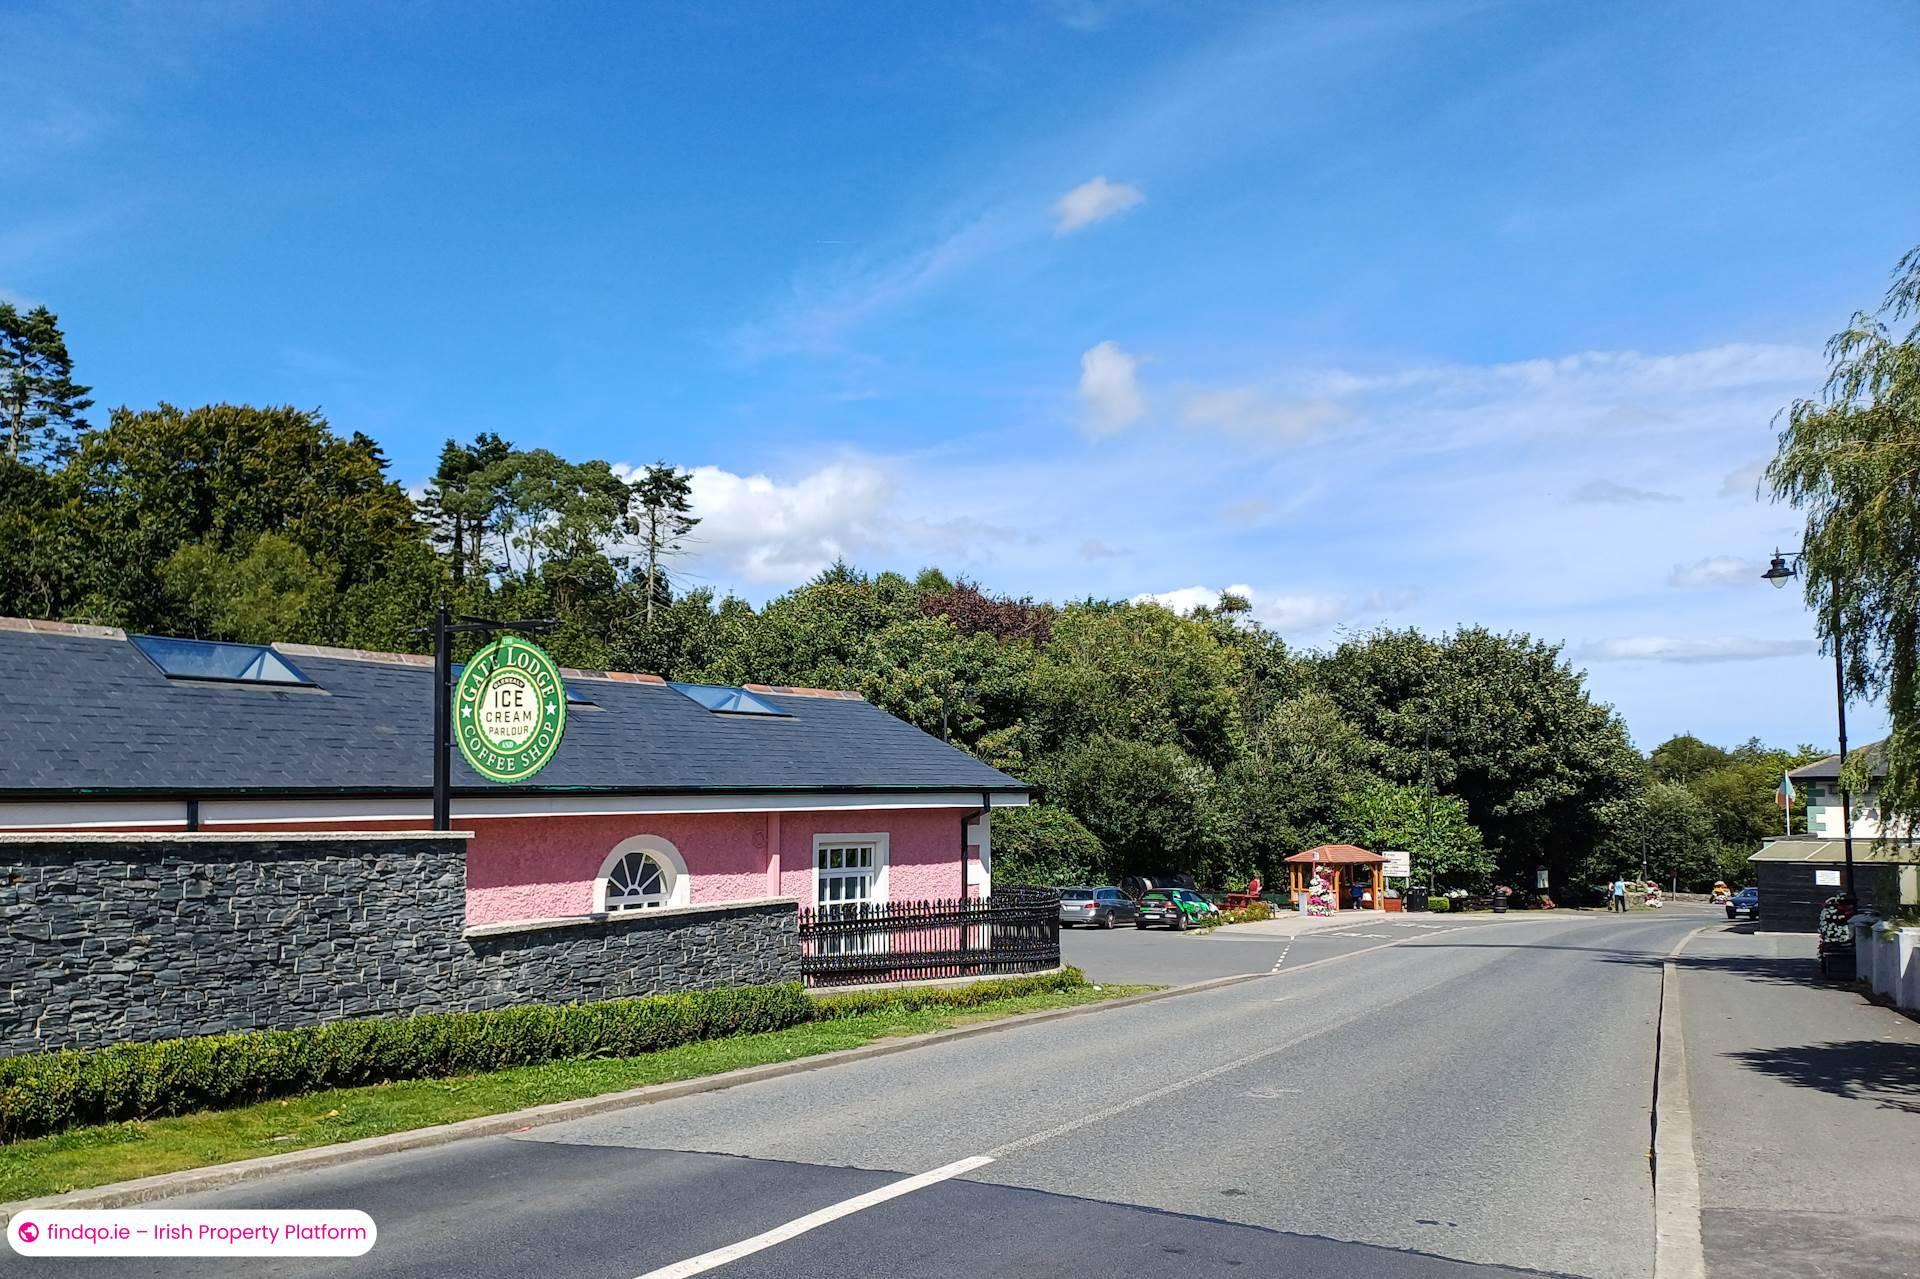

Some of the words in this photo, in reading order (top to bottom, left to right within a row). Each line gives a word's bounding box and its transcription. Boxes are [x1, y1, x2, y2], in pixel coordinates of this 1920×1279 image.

[462, 654, 500, 702] GATE
[507, 647, 556, 698] LODGE
[495, 690, 524, 709] ICE
[486, 710, 532, 723] CREAM
[488, 725, 529, 737] PARLOUR
[464, 725, 516, 771] COFFEE
[520, 721, 555, 767] SHOP
[502, 741, 514, 749] AND
